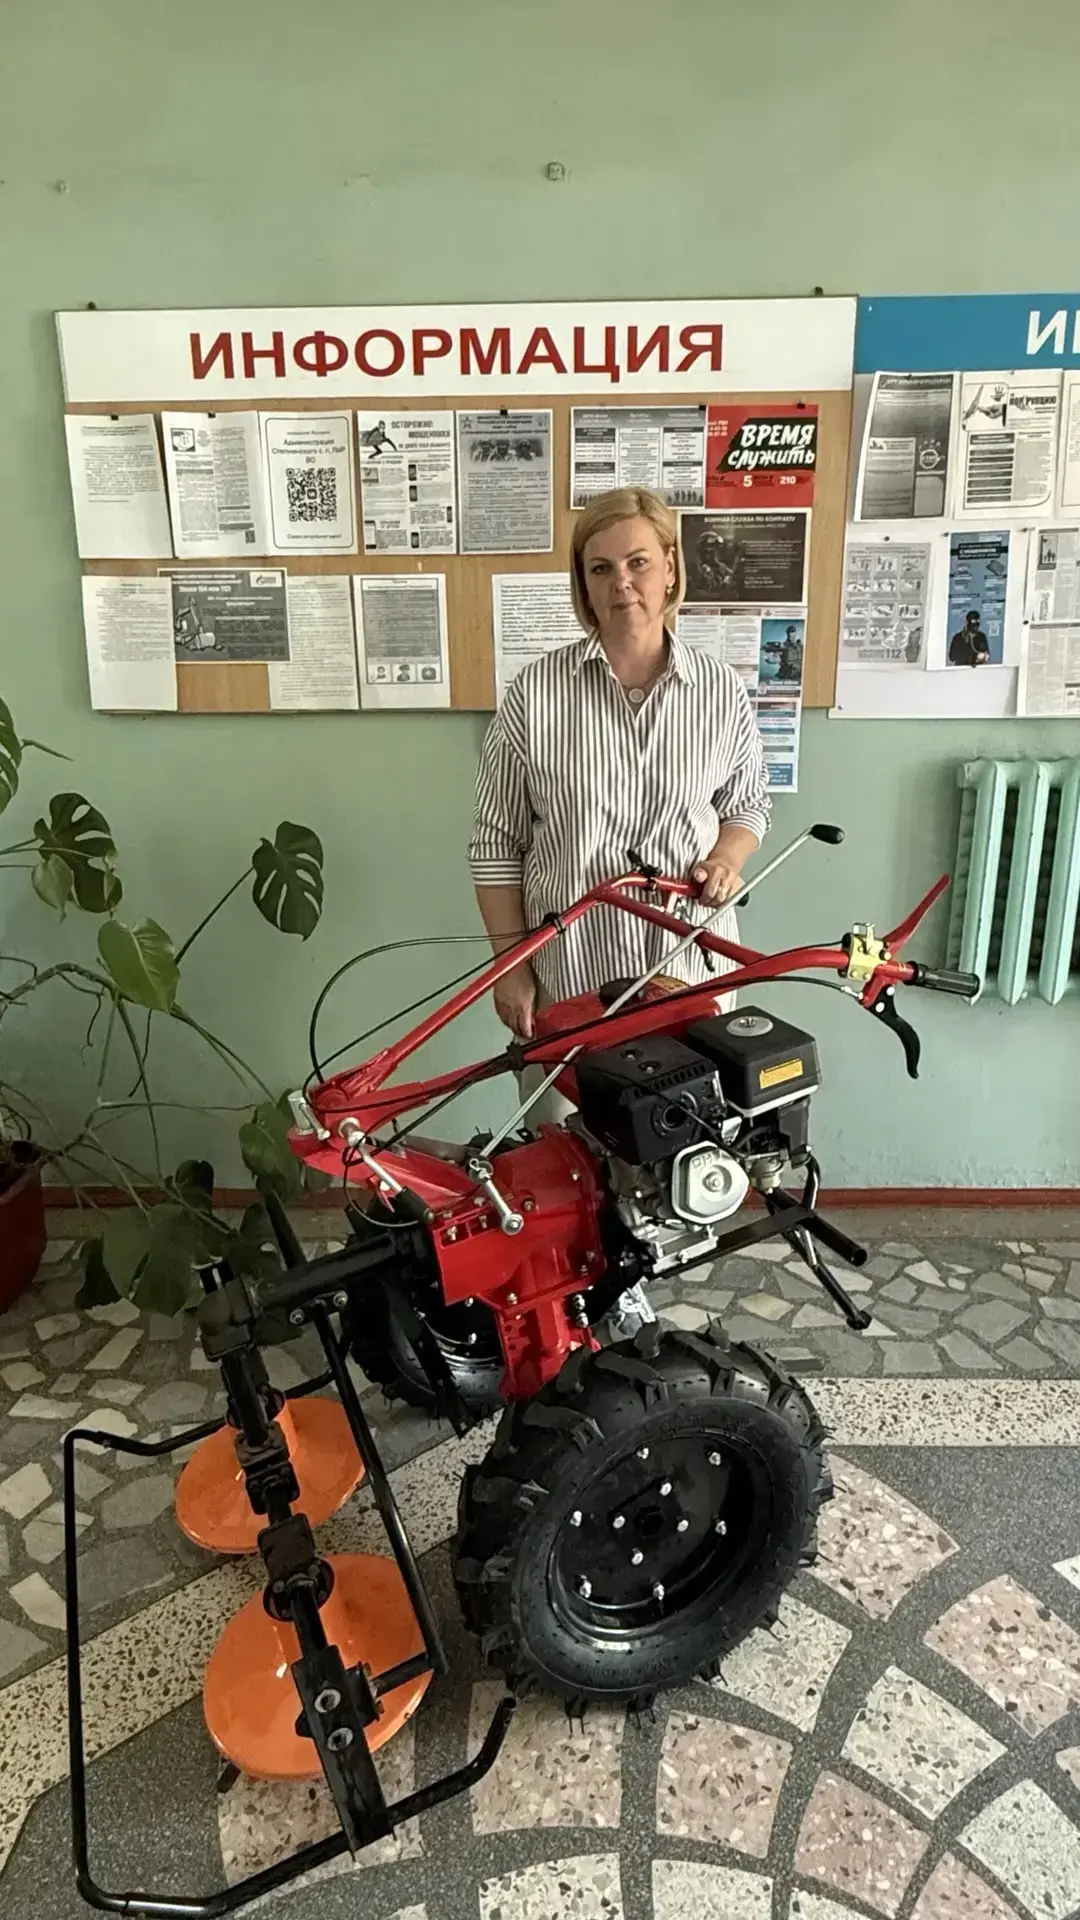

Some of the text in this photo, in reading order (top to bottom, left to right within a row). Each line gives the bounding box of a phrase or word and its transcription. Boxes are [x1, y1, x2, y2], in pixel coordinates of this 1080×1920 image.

[1026, 309, 1080, 355] И
[189, 324, 724, 383] ИНФОРМАЦИЯ
[740, 424, 816, 448] ВРЕМЯ
[743, 475, 753, 488] 5
[780, 476, 797, 485] 210
[885, 648, 902, 659] 112
